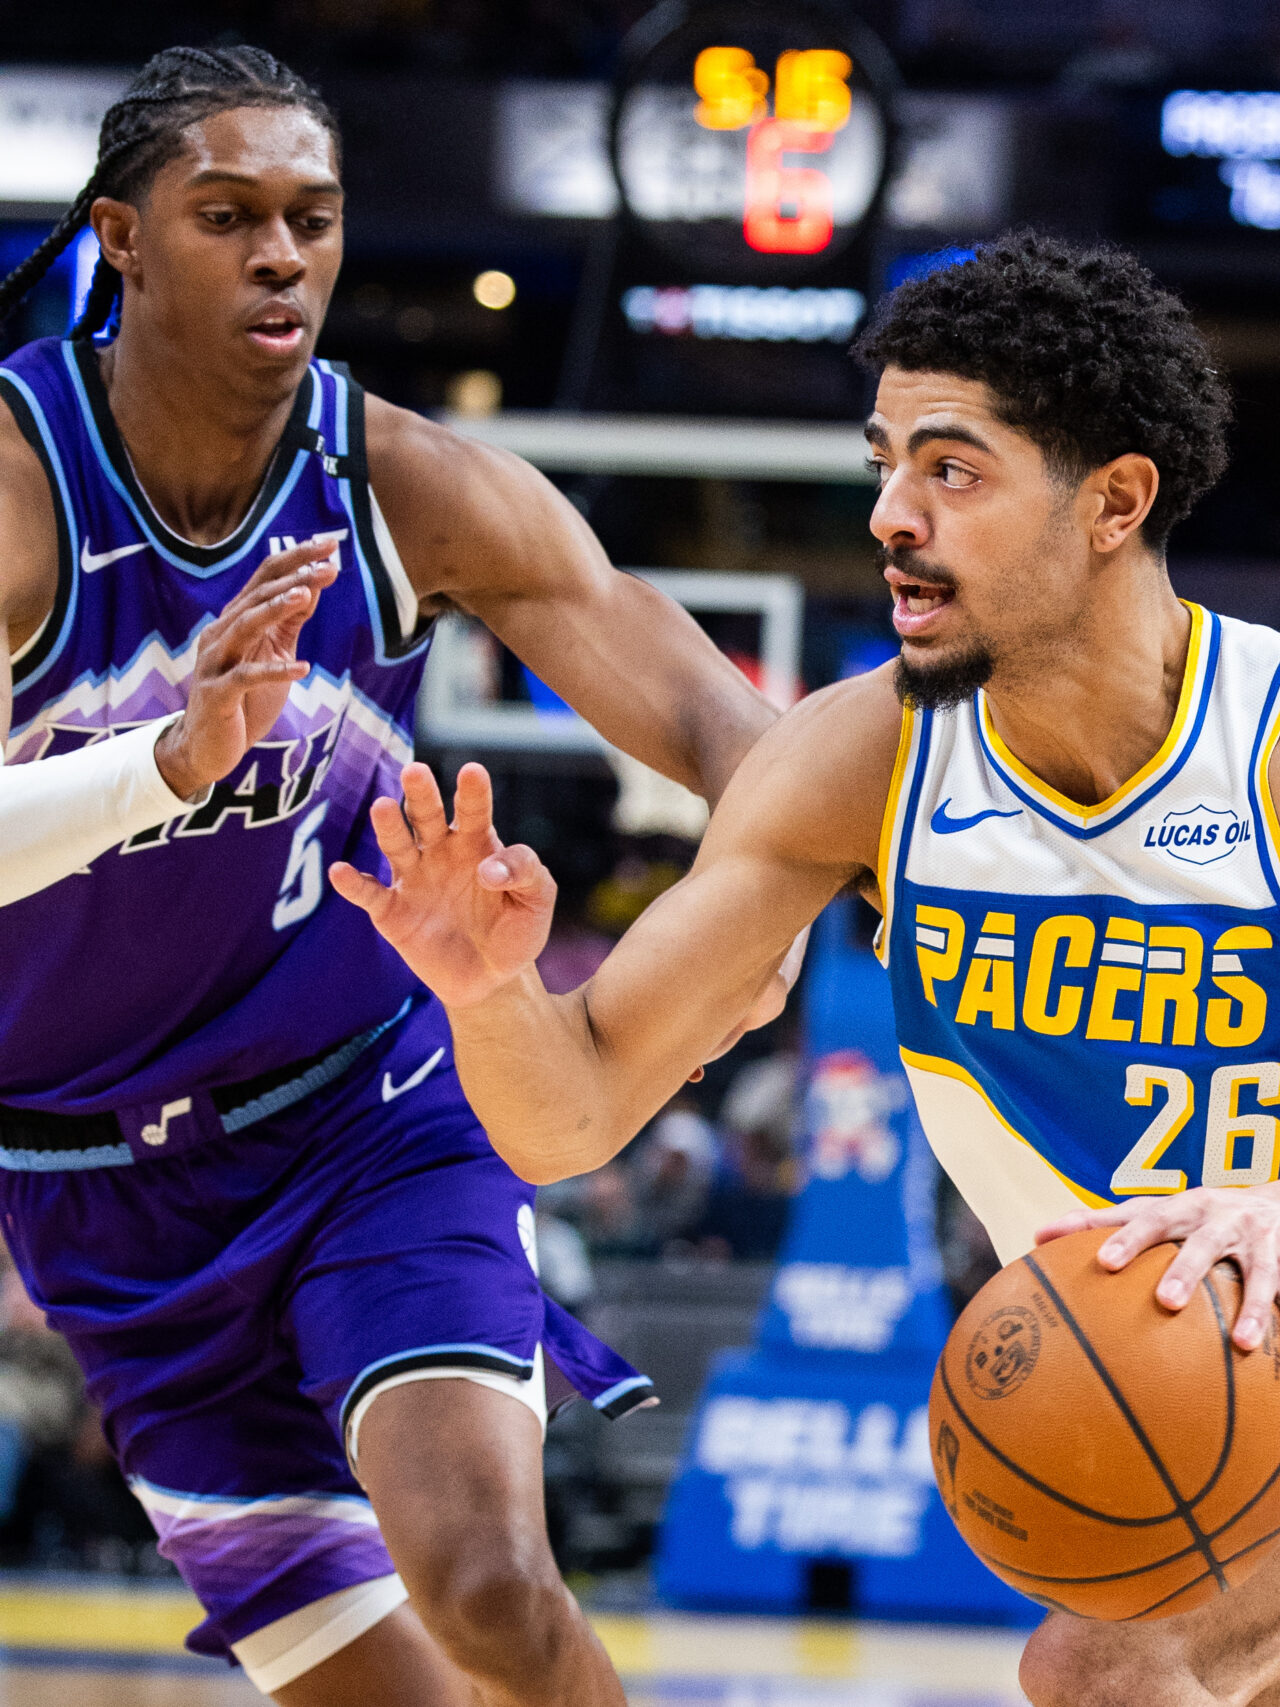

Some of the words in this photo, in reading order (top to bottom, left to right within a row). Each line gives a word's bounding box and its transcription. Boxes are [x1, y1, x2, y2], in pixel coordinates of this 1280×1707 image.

[743, 117, 834, 254] 6
[272, 800, 330, 931] 5
[1143, 824, 1220, 848] LUCAS
[1224, 819, 1252, 845] OIL
[915, 903, 1274, 1049] PACERS
